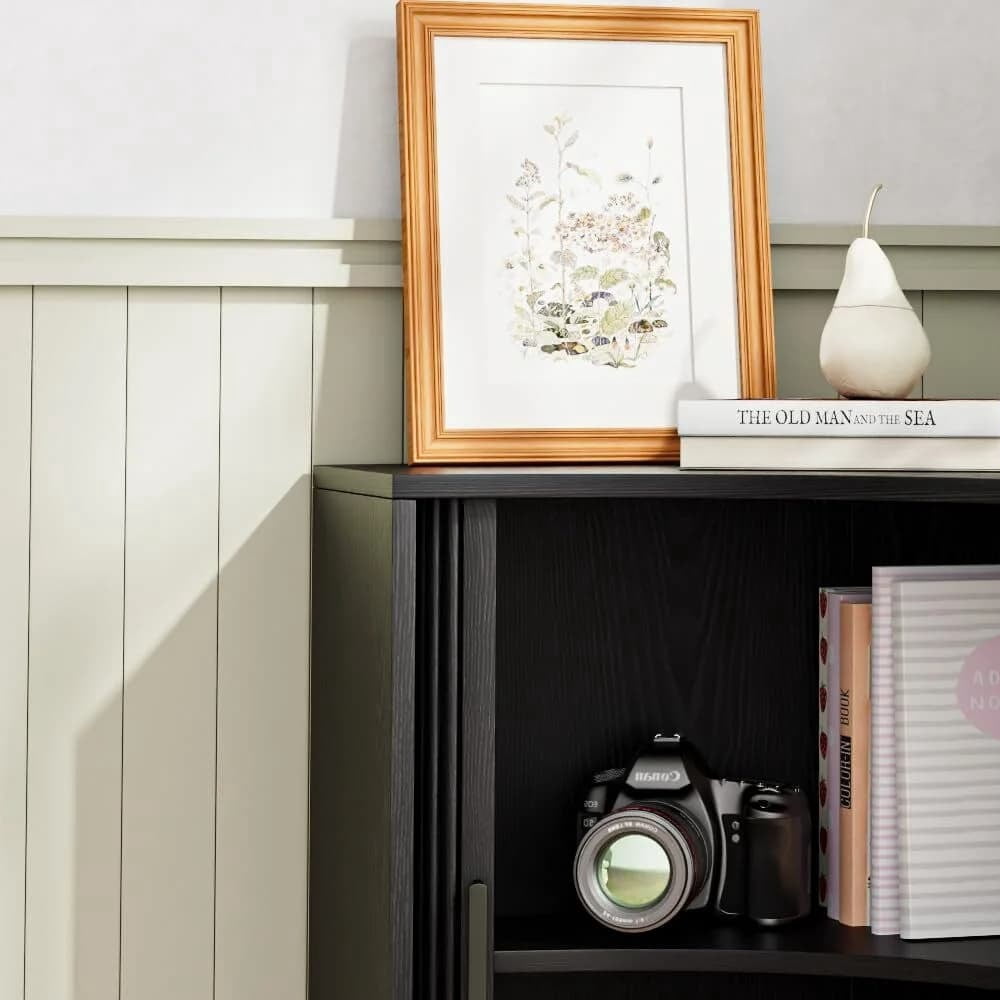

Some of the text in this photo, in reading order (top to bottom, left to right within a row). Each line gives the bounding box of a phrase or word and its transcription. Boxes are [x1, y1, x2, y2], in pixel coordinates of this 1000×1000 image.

[737, 409, 937, 426] THE OLD MAN AND THE SEA
[840, 688, 850, 726] BOOK
